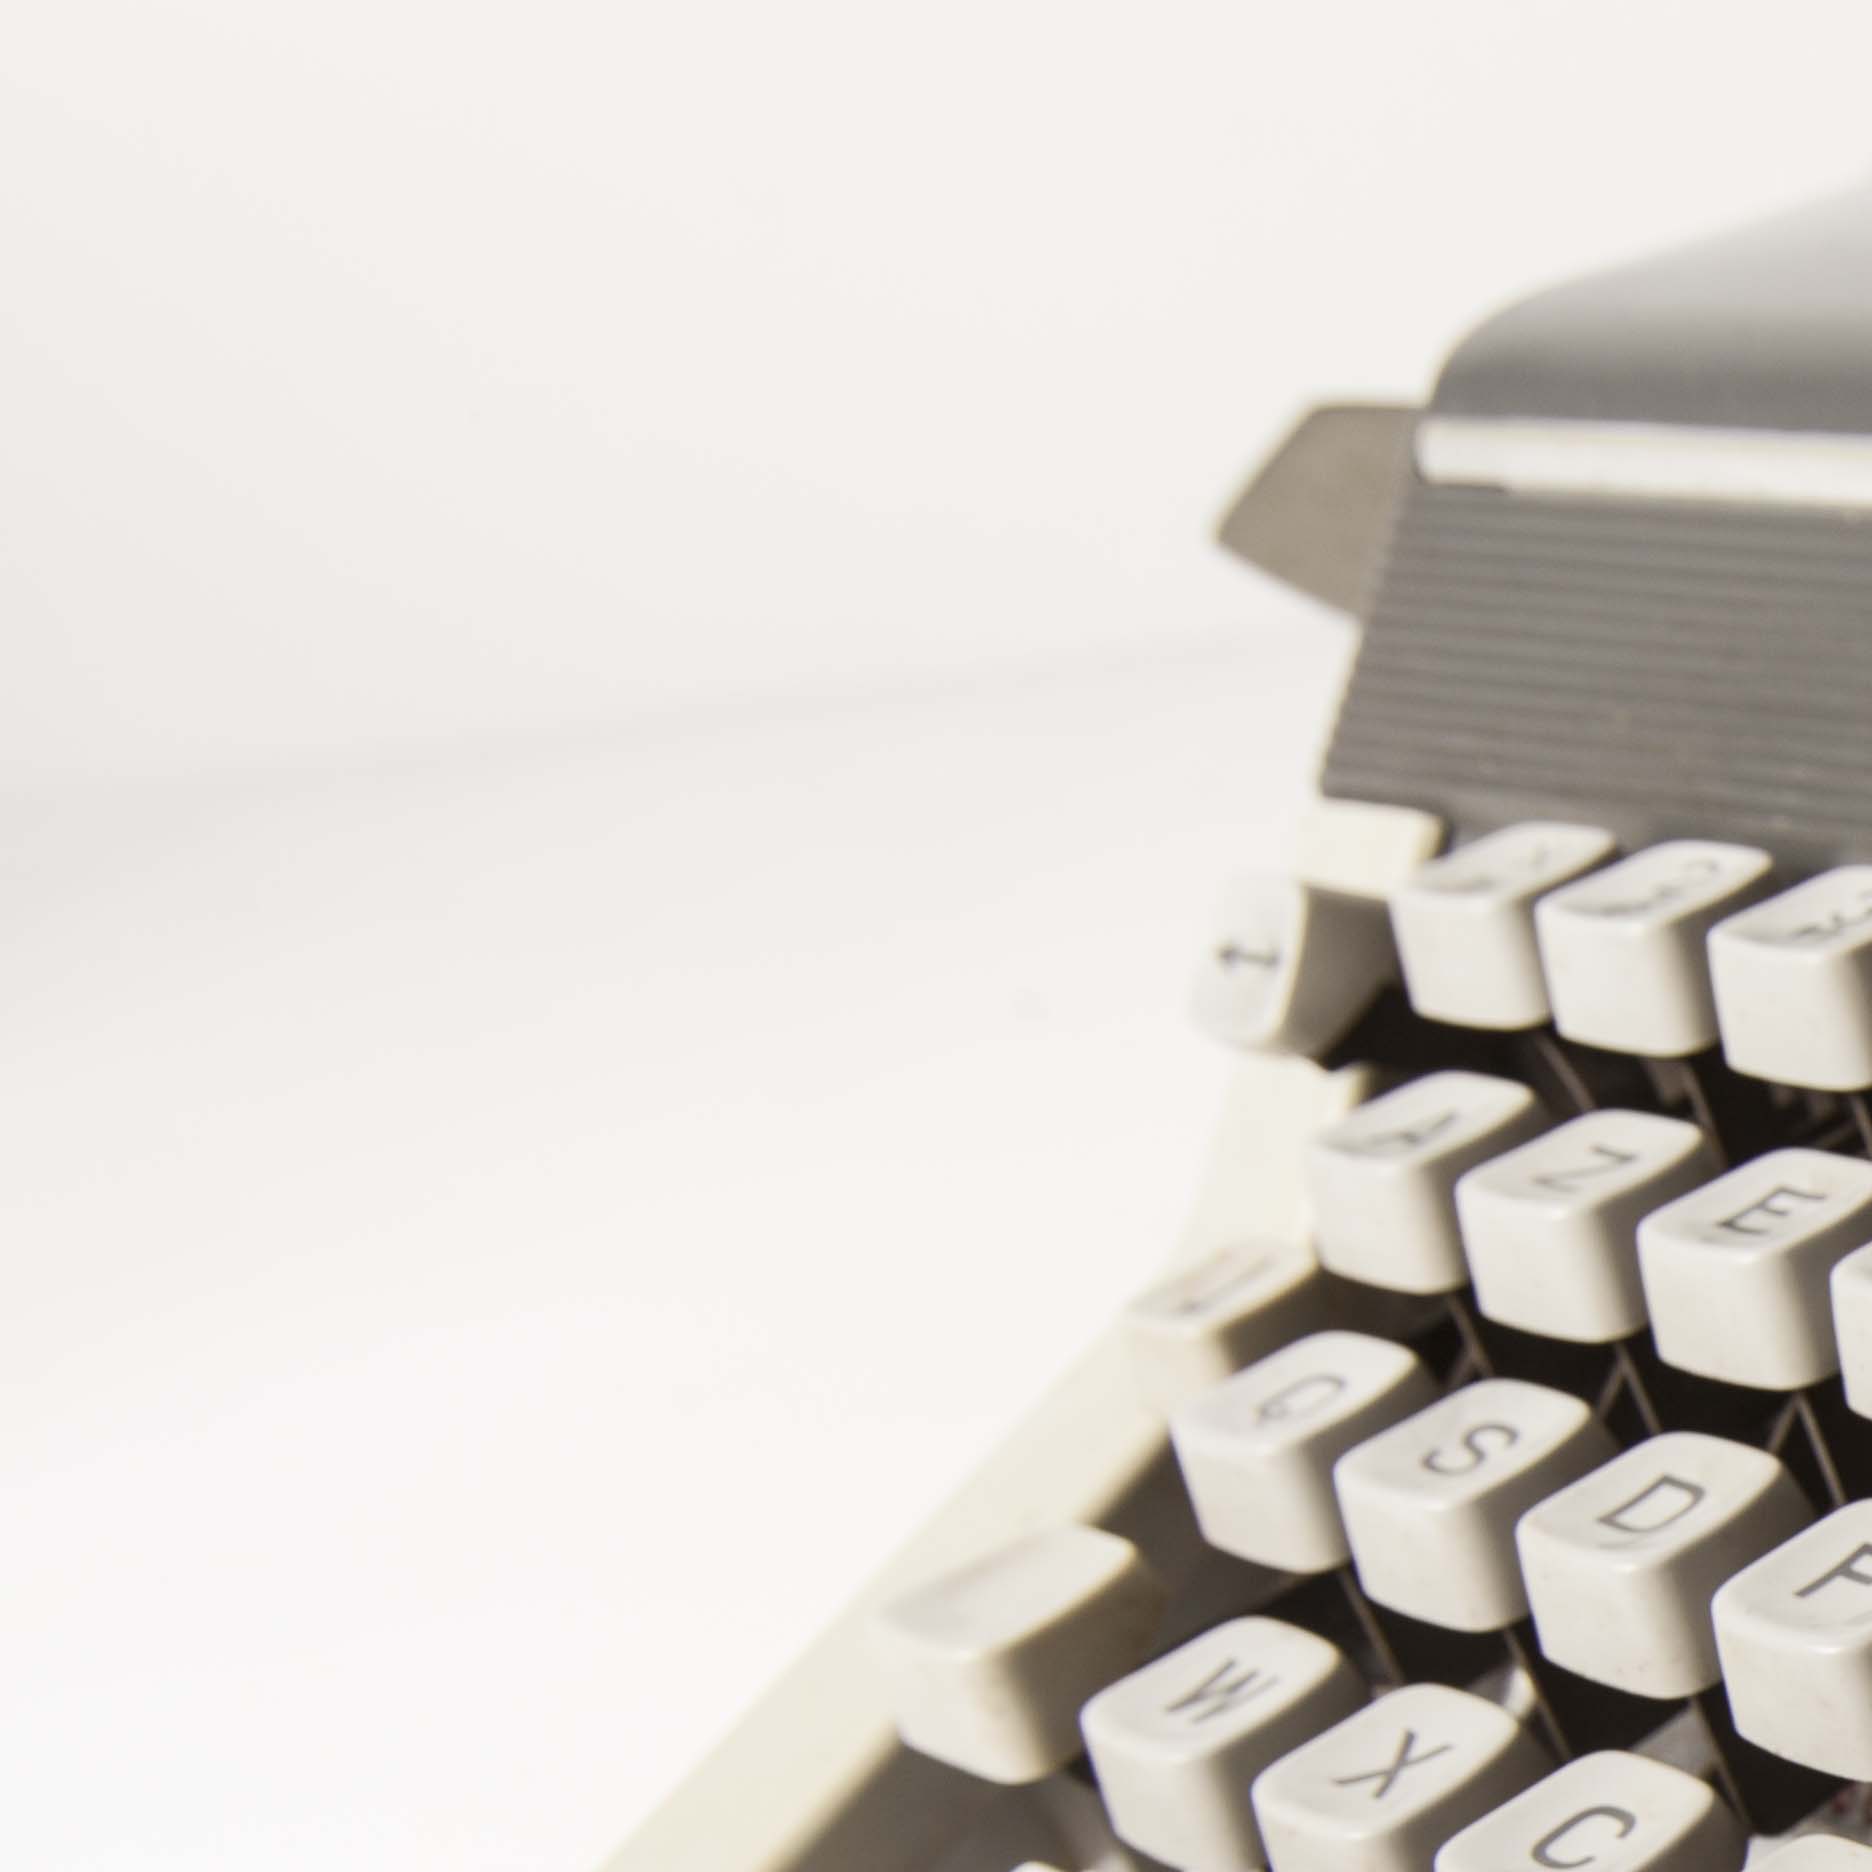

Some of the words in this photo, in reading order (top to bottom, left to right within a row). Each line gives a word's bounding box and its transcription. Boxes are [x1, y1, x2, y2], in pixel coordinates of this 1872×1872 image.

[1358, 1110, 1460, 1147] A
[1537, 1145, 1637, 1193] Z
[1717, 1185, 1828, 1237] E
[1423, 1422, 1520, 1477] S
[1596, 1474, 1704, 1534] D
[1165, 1658, 1278, 1723] W
[1335, 1730, 1454, 1799] X
[1531, 1805, 1636, 1872] C
